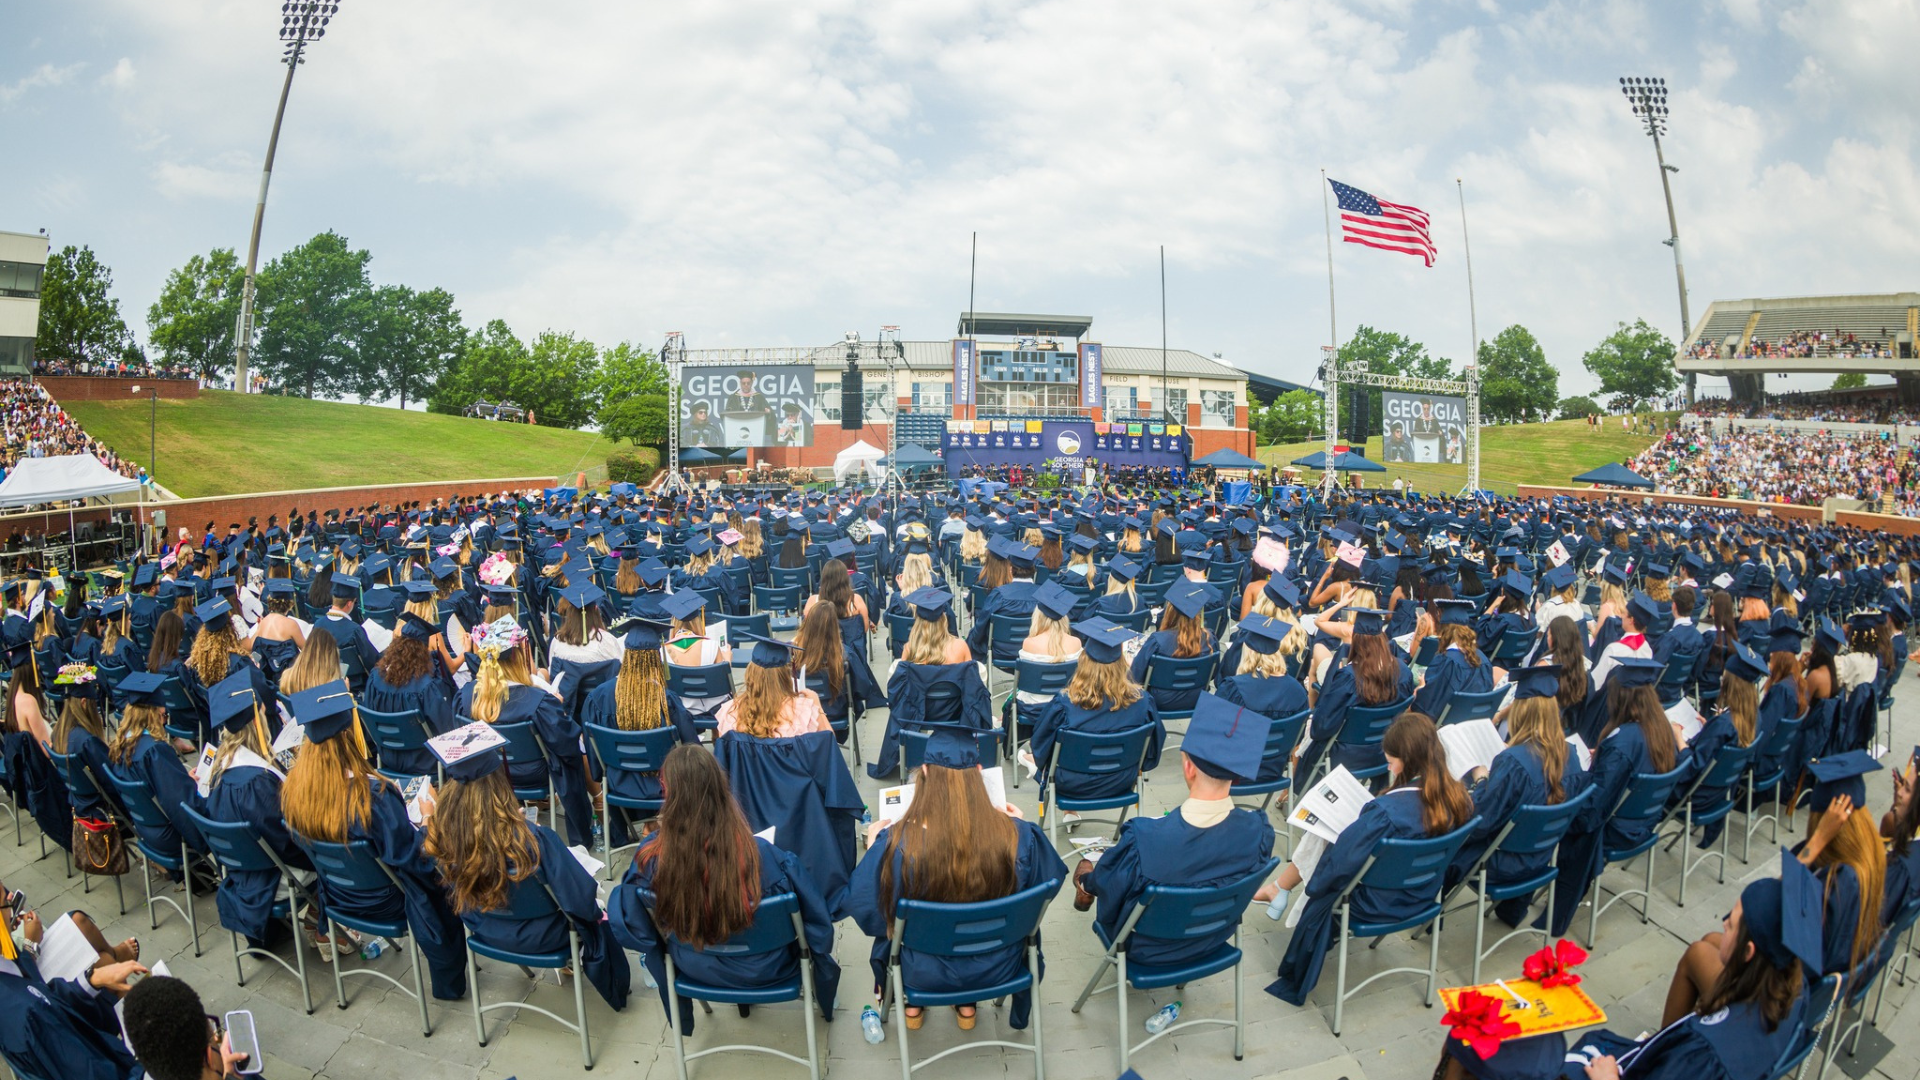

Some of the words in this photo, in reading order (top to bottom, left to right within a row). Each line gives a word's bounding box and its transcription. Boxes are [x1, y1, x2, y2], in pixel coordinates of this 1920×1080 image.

[961, 348, 969, 369] NEST
[1088, 350, 1096, 371] NEST
[961, 370, 969, 401] EAGLES
[1088, 372, 1096, 403] EAGLES
[1109, 375, 1128, 383] FIELD
[680, 397, 814, 419] SOUERN
[1383, 418, 1466, 441] SOUERN
